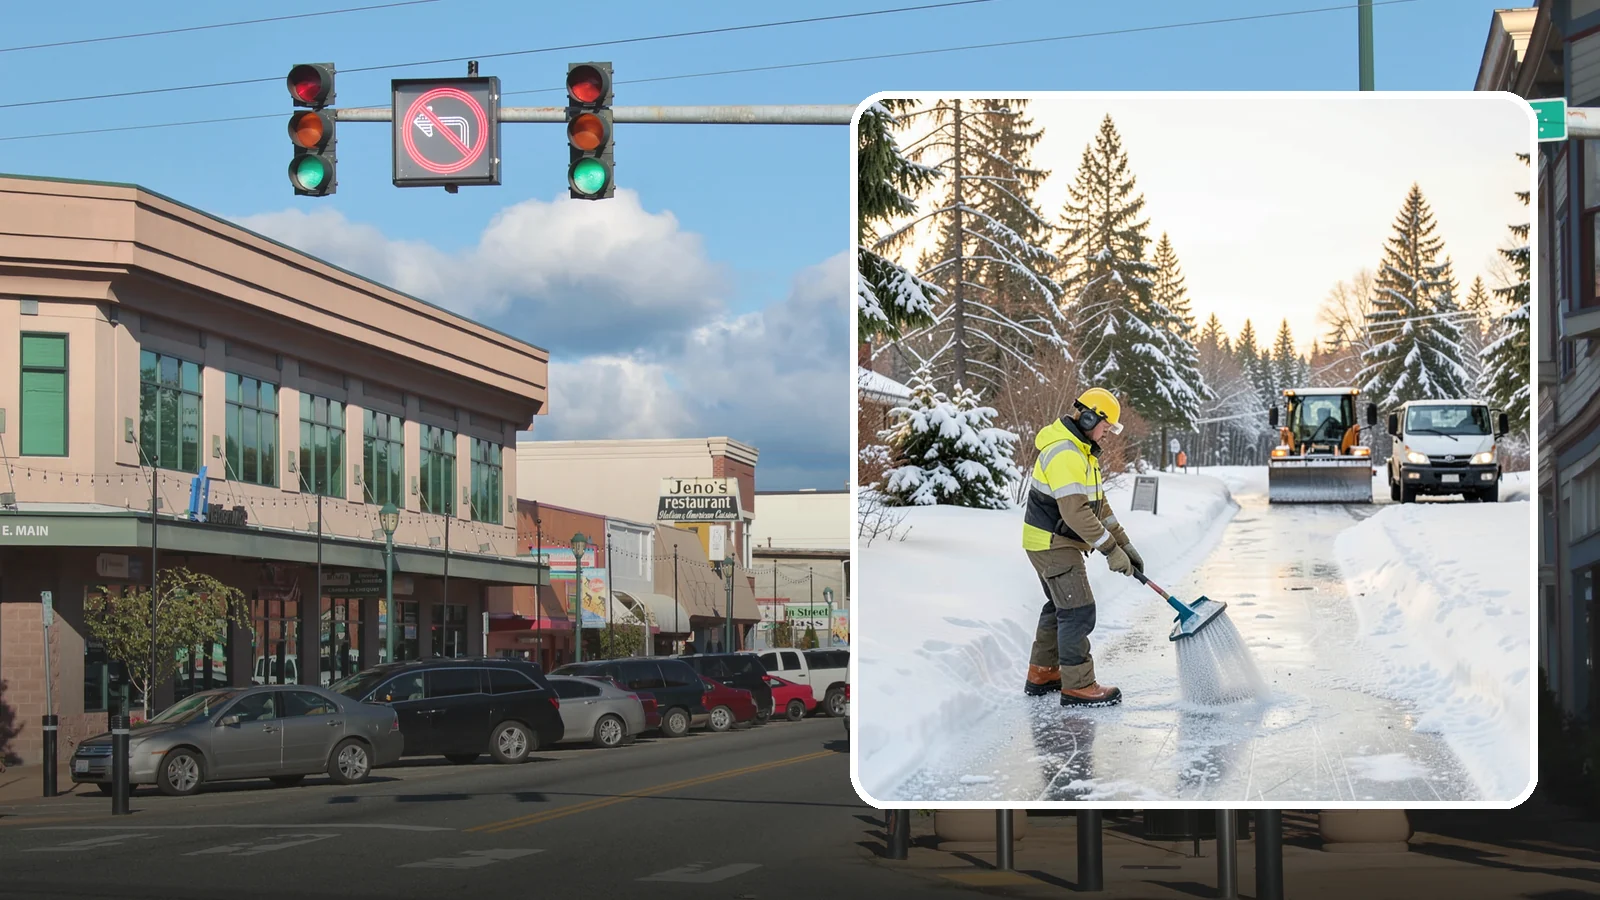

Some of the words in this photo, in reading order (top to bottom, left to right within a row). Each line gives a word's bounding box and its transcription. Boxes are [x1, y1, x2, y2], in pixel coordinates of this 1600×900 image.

[670, 480, 727, 494] Jeno's
[665, 496, 730, 508] restaurant
[658, 509, 681, 519] Italian
[686, 509, 714, 519] American
[715, 510, 737, 519] Cuisine
[2, 525, 13, 536] E.
[15, 525, 49, 536] MAIN
[797, 608, 828, 616] Street
